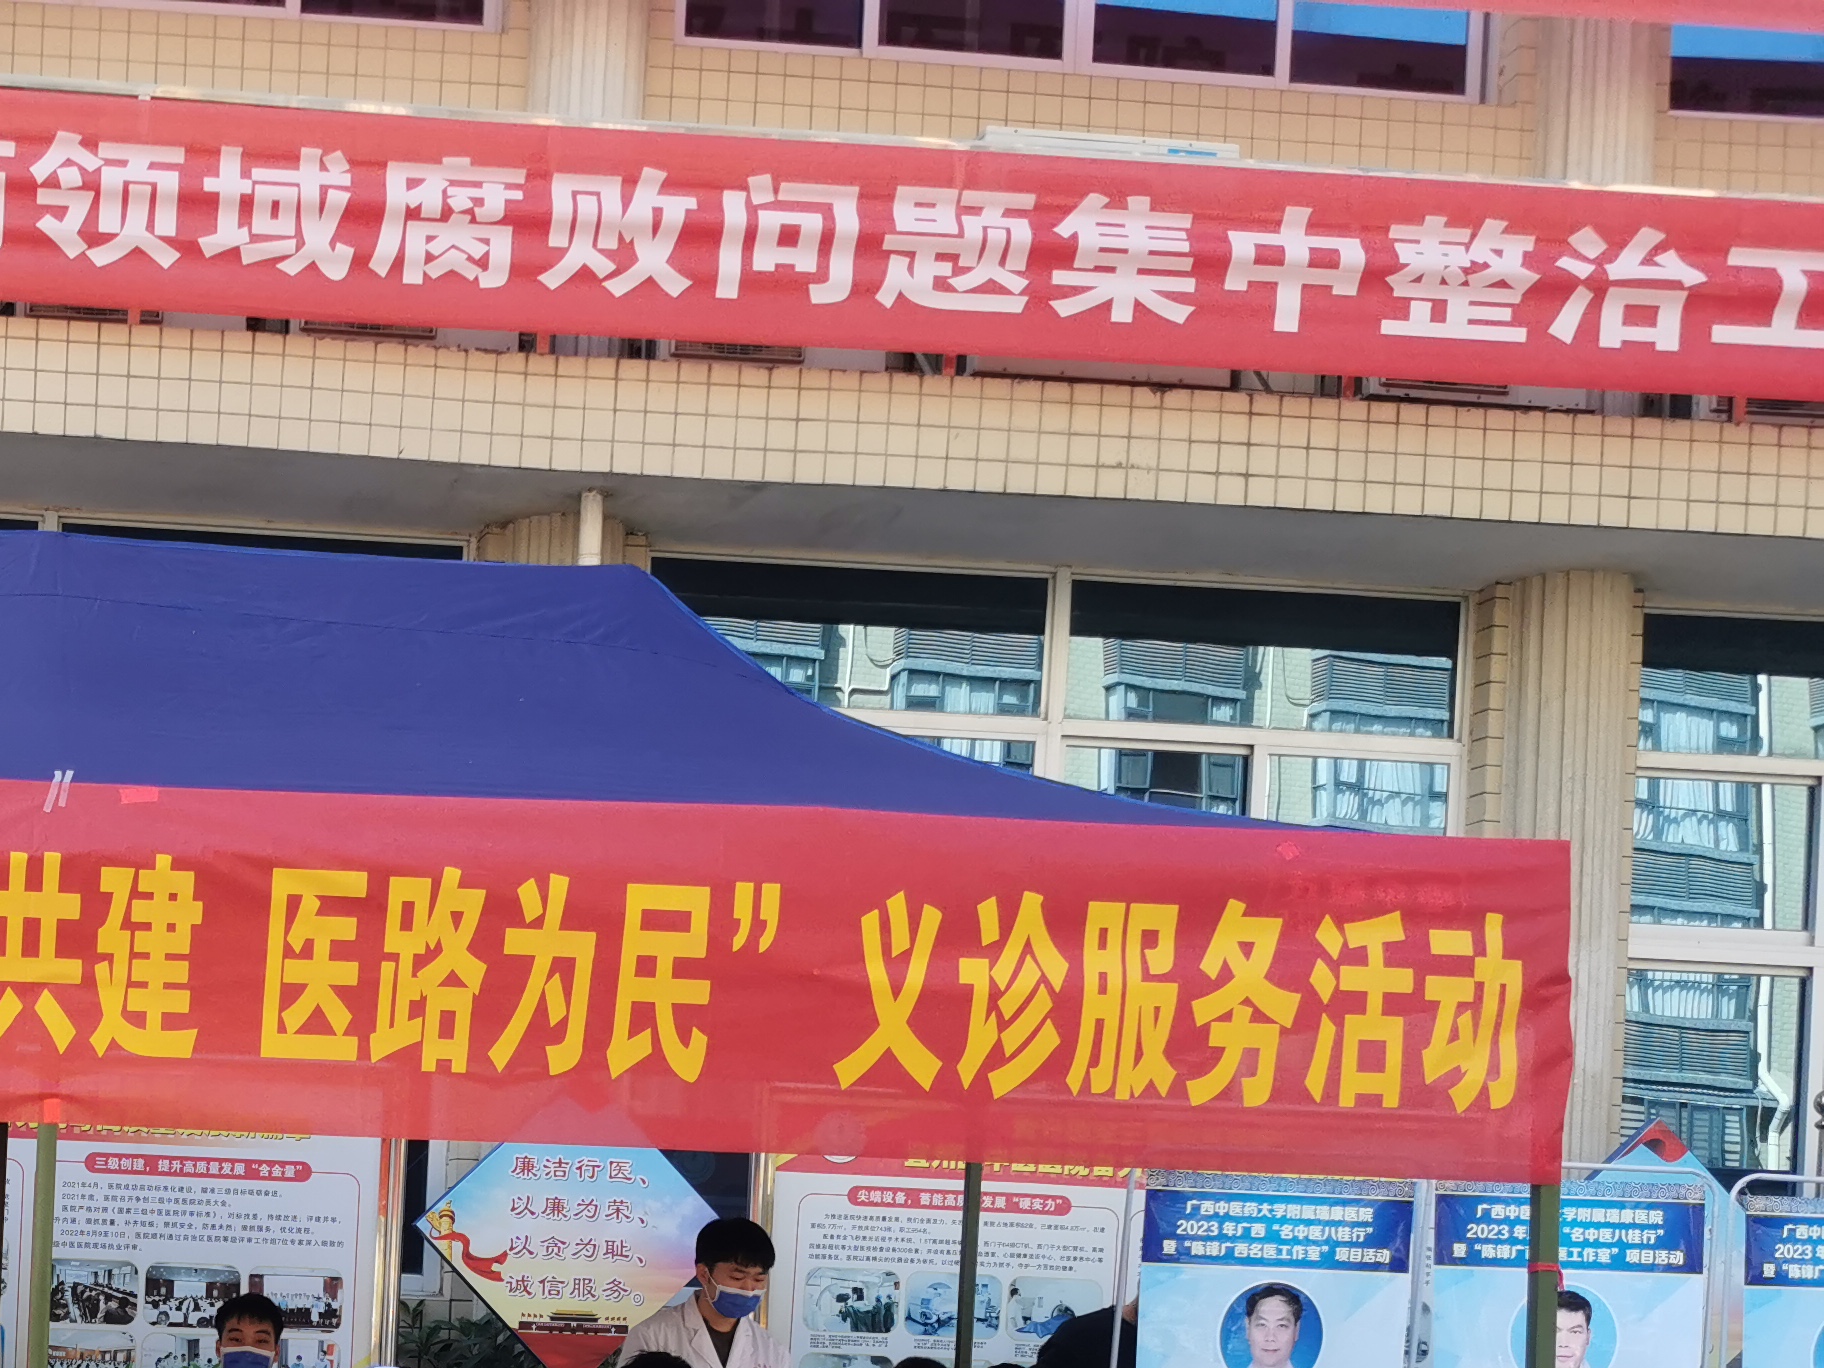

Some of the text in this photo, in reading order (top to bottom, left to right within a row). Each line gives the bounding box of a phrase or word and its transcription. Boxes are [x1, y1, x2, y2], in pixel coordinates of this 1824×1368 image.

[832, 890, 1524, 1114] 义诊服务活动
[857, 1190, 1063, 1212] 尖端设备，蓄能高质发展“硬实力”
[1186, 1200, 1374, 1222] 广西中医药大学附属瑞康医院
